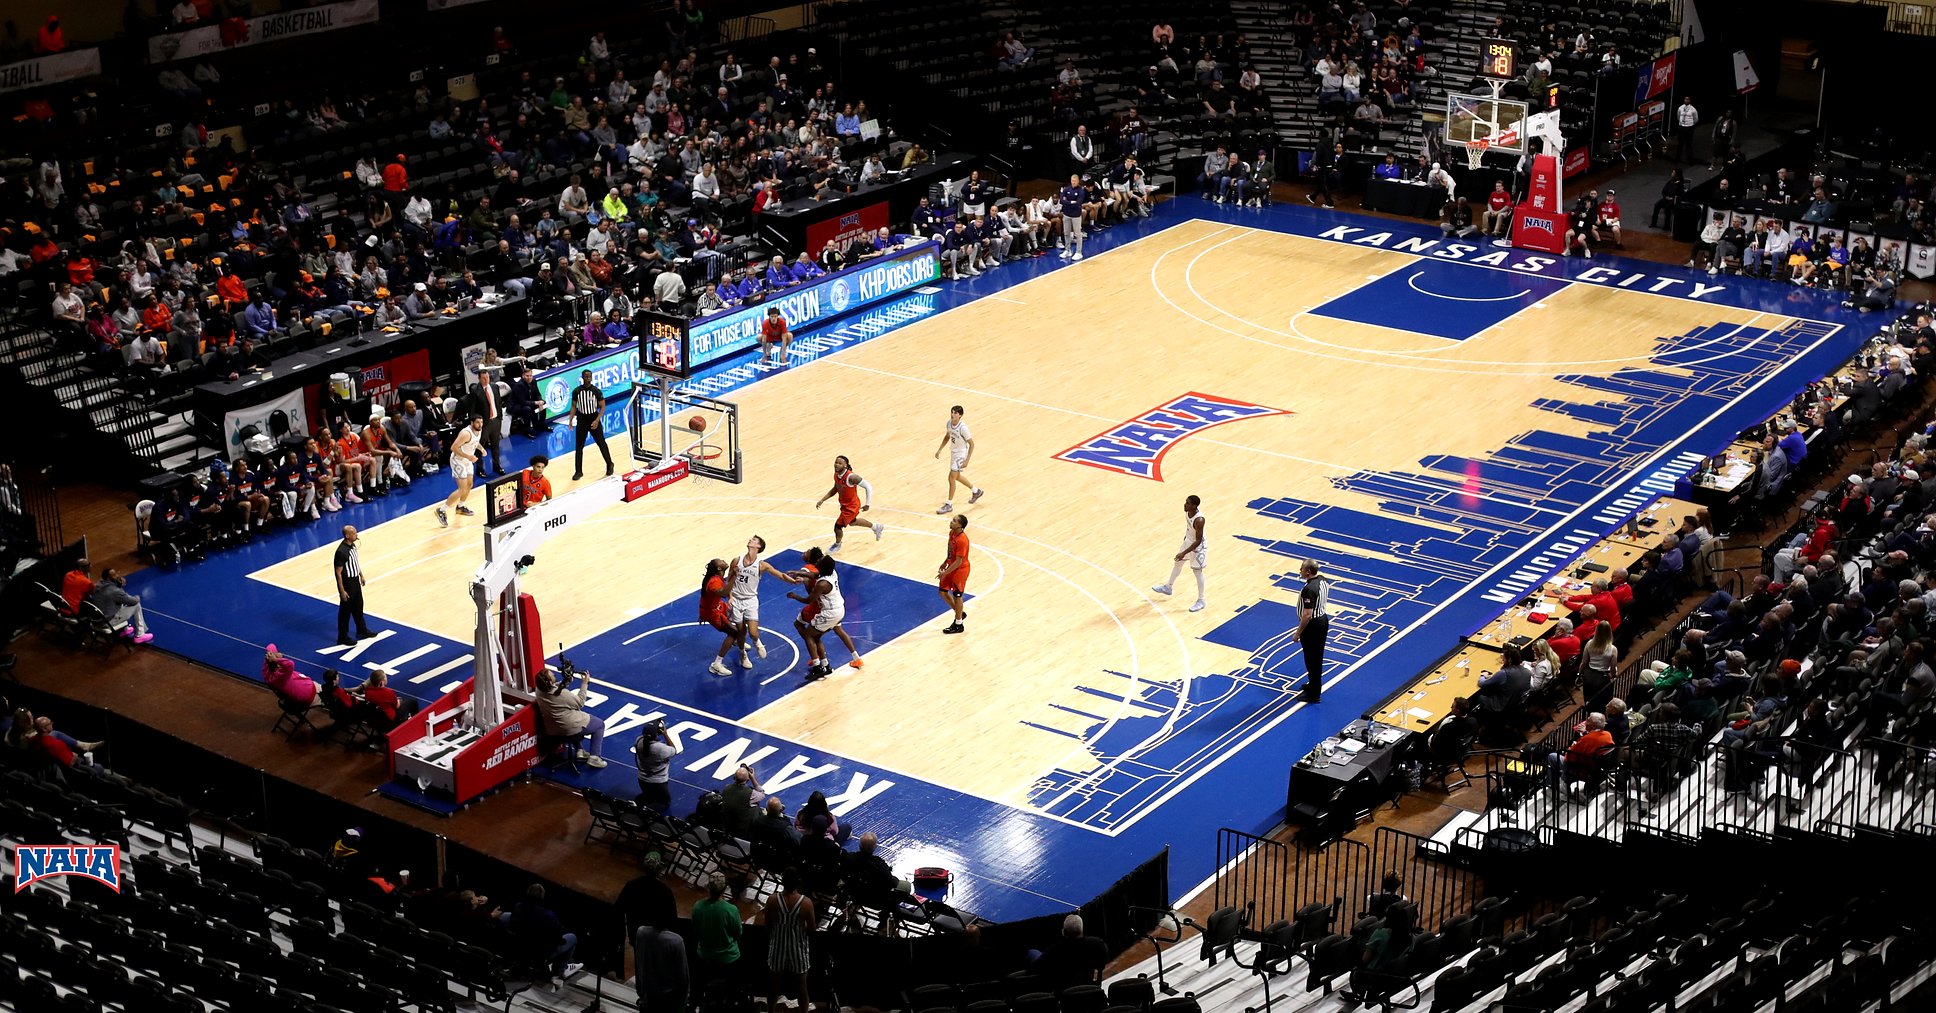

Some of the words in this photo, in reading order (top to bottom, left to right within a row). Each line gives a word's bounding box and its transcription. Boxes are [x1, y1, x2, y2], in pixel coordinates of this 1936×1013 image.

[262, 9, 333, 38] BASKETBALL
[1489, 44, 1512, 57] 13:04
[1494, 57, 1508, 75] 18
[839, 213, 860, 231] NAIA
[1523, 217, 1553, 234] NAIA
[1317, 225, 1557, 273] KANSAS
[1575, 266, 1727, 299] CITY
[651, 322, 680, 340] 13:04
[693, 333, 712, 355] FOR
[712, 323, 741, 347] THOSE
[742, 320, 755, 339] ON
[755, 317, 763, 333] A
[762, 288, 820, 328] SSION
[621, 363, 629, 382] A
[1057, 395, 1284, 478] NAIA
[647, 467, 685, 489] NAIAHOOPS.COM
[544, 514, 567, 532] PRO
[739, 574, 749, 584] 24
[315, 629, 474, 691] ITY
[502, 721, 521, 740] NAIA
[485, 752, 504, 770] RED
[584, 689, 896, 817] KANSA
